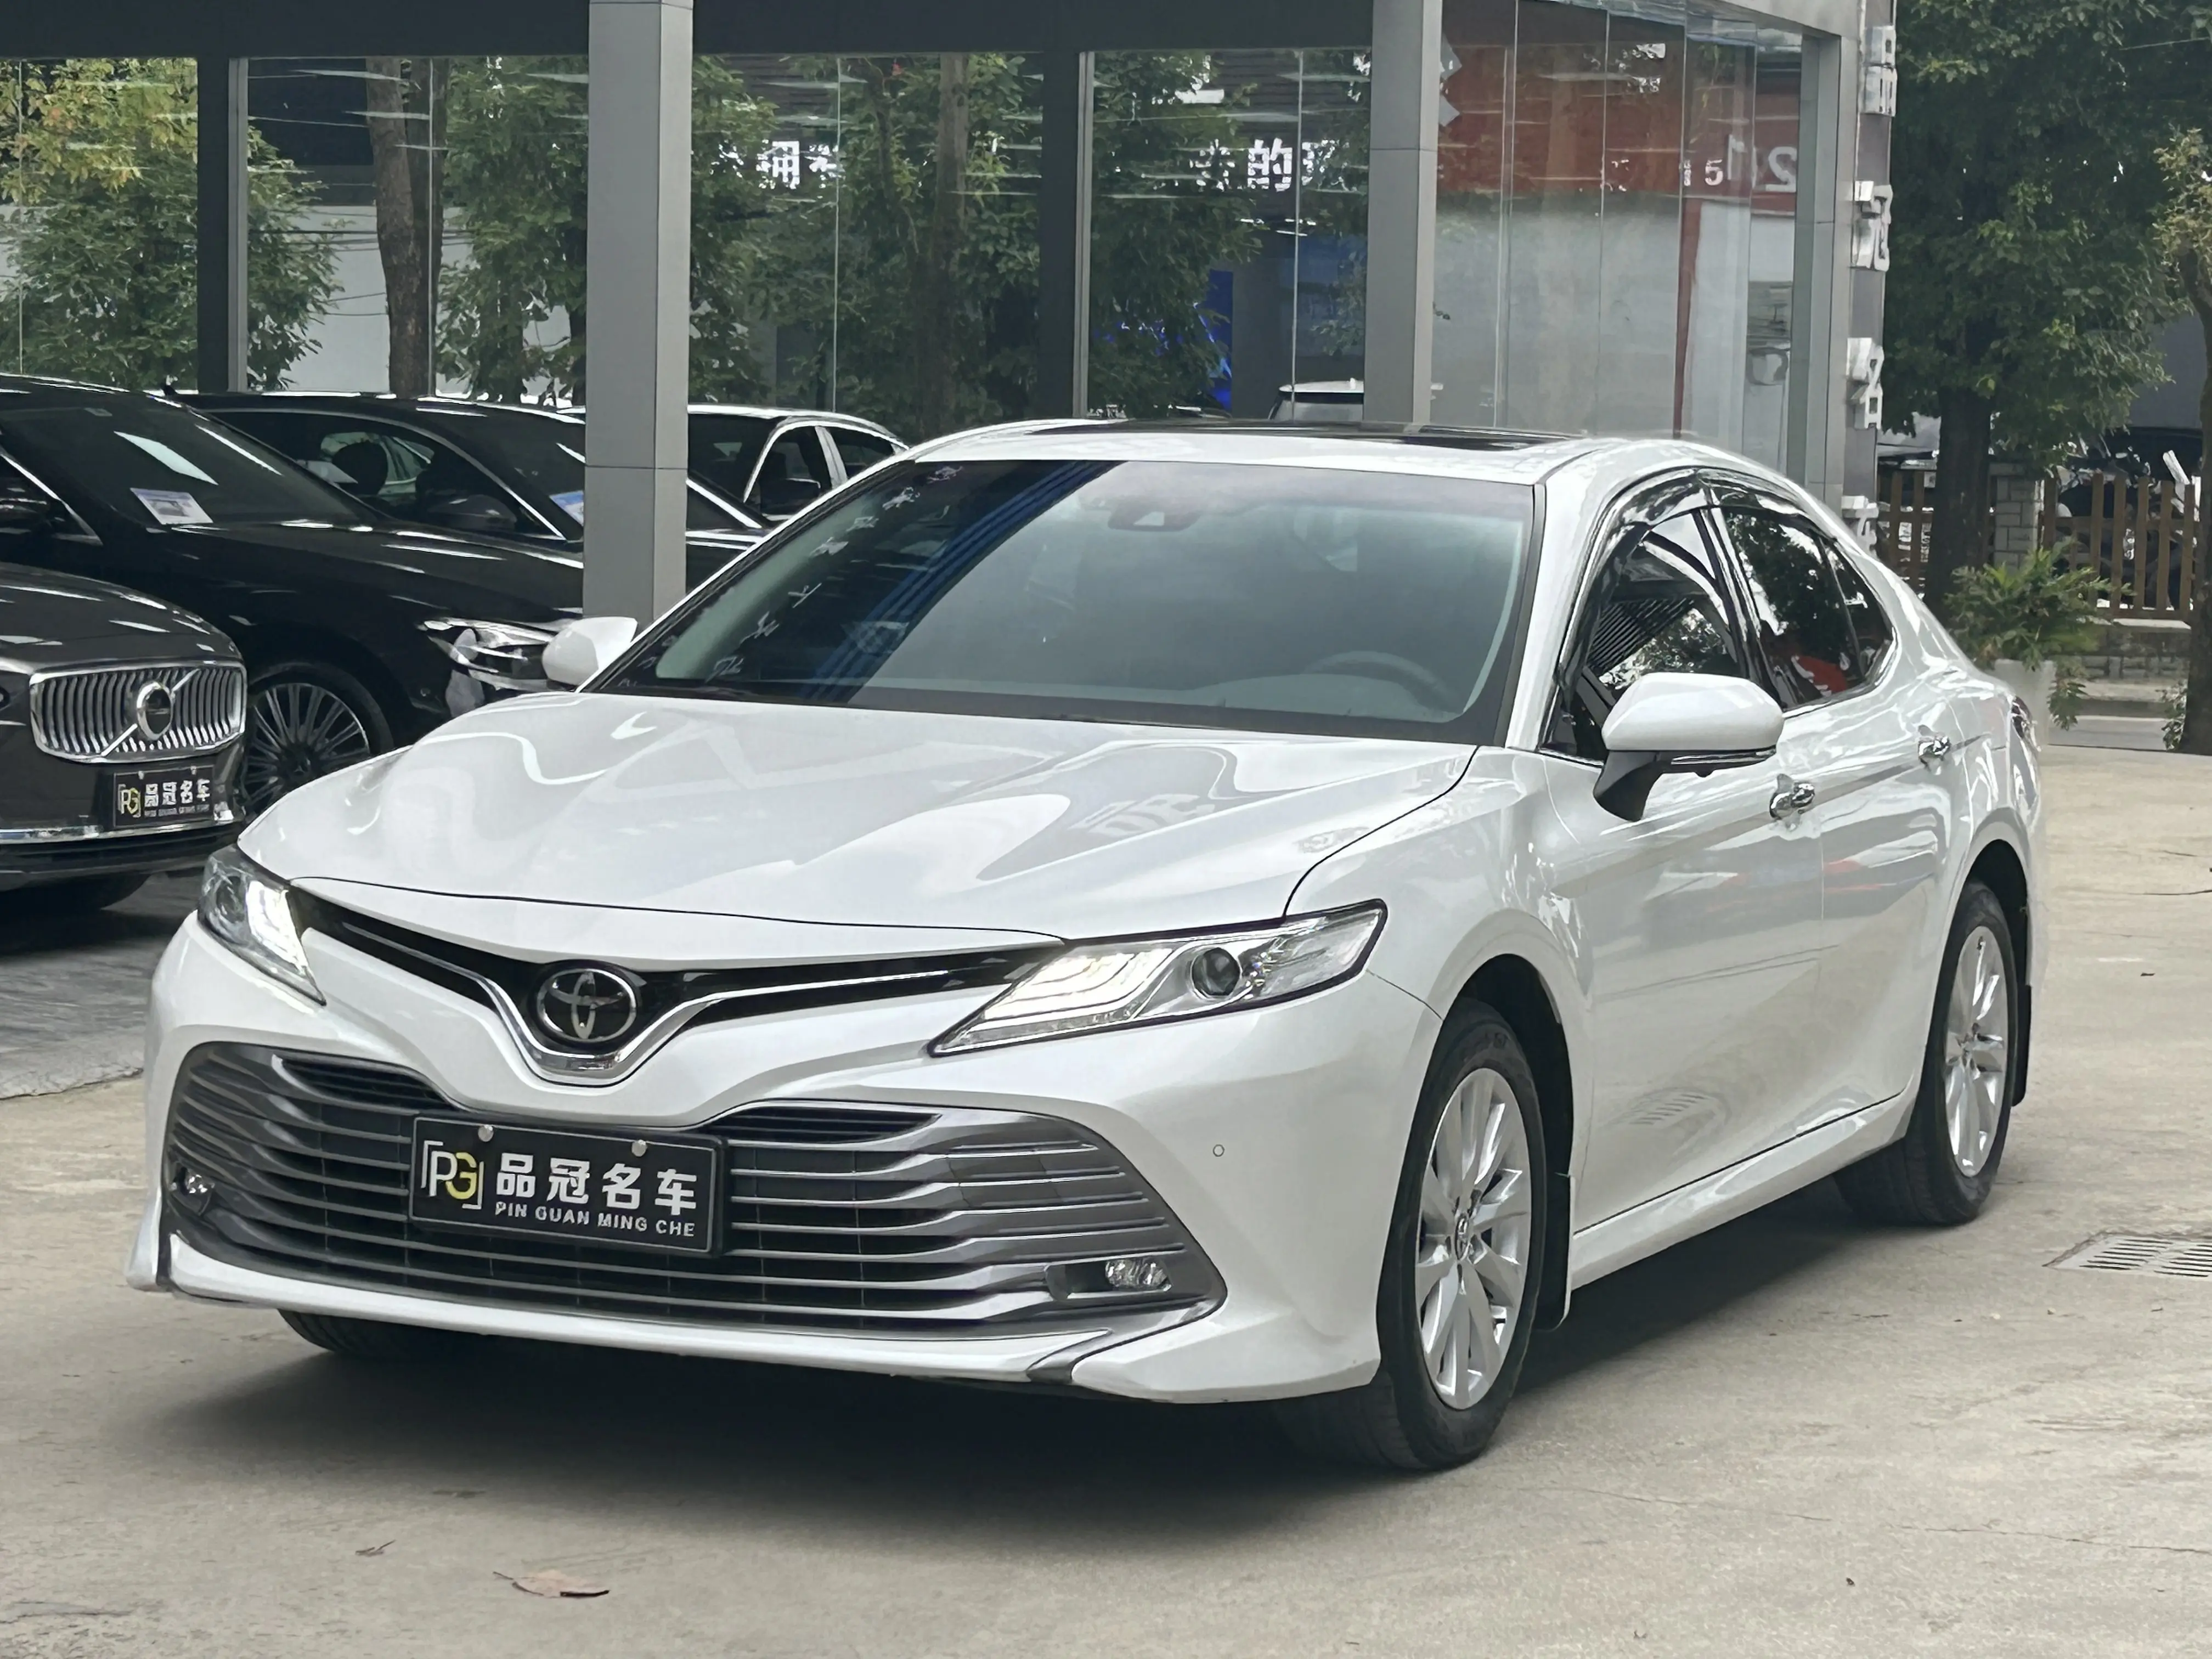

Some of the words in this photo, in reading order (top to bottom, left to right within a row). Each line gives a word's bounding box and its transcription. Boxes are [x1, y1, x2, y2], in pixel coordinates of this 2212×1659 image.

[428, 1148, 478, 1201] PG
[495, 1152, 697, 1216] 品冠名车
[495, 1201, 528, 1217] PIN
[597, 1212, 648, 1232] MING
[656, 1220, 696, 1237] CHE
